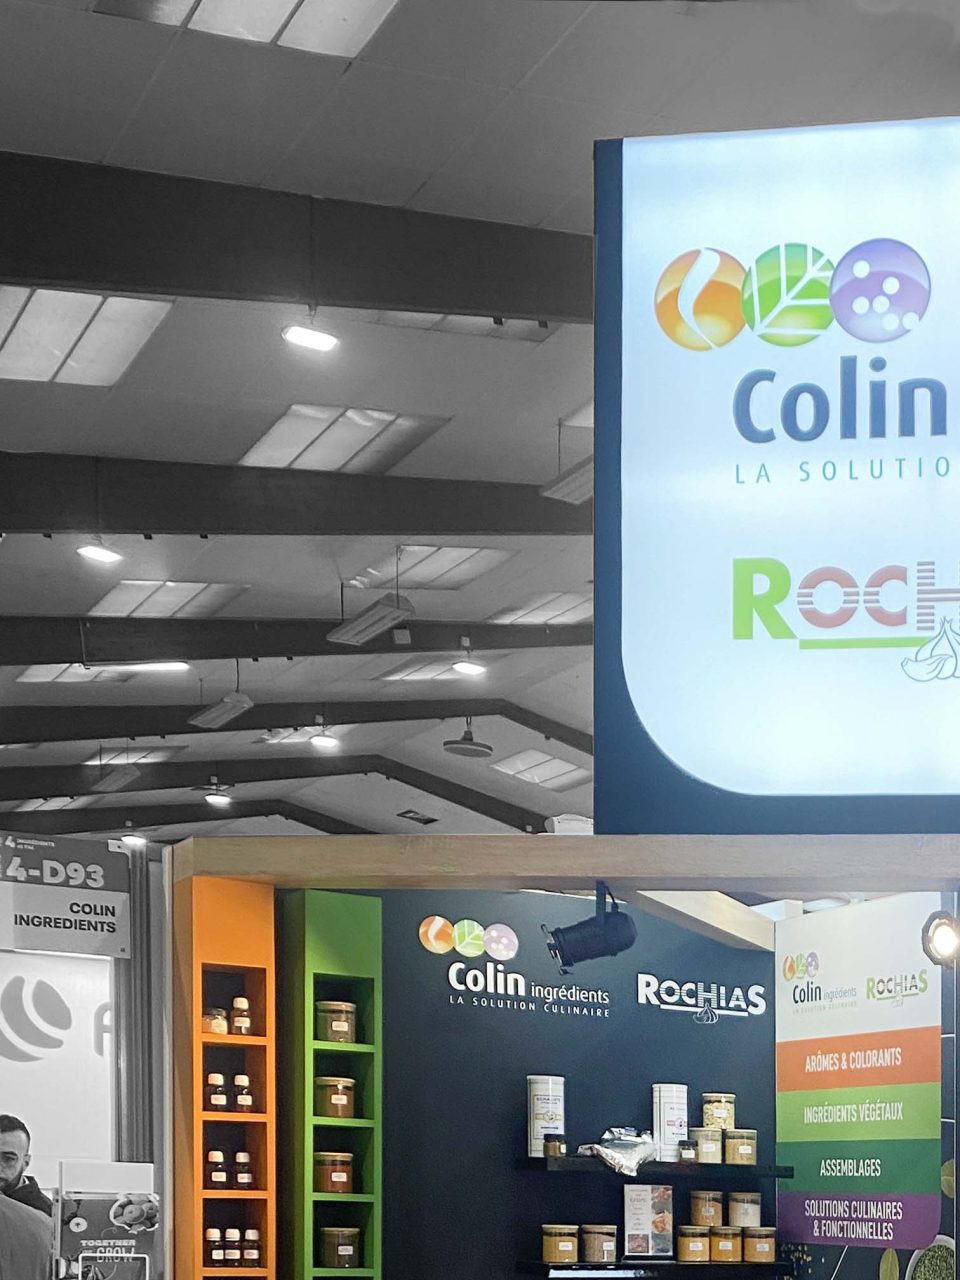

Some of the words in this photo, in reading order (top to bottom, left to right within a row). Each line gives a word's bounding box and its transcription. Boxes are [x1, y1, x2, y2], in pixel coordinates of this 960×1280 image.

[733, 355, 947, 444] Colin
[735, 463, 771, 484] LA
[69, 902, 116, 917] COLIN
[14, 914, 116, 933] INGREDIENTS
[448, 962, 526, 996] Colin
[531, 982, 609, 1004] ingrédients
[637, 973, 766, 1016] ROCHIAS
[793, 981, 822, 1004] Colin
[866, 968, 928, 1000] ROCHIAS
[450, 995, 464, 1005] LA
[472, 997, 536, 1011] SOLUTION
[544, 1004, 609, 1018] CULINAIRE
[805, 1049, 839, 1073] ARÔMES
[840, 1052, 848, 1070] &
[849, 1047, 902, 1069] COLORANTS
[804, 1101, 858, 1124] INGRÉDIENTS
[858, 1098, 904, 1121] VÉGÉTAUX
[819, 1159, 881, 1177] ASSEMBLAGES
[804, 1199, 850, 1218] SOLUTIONS
[850, 1200, 903, 1220] CULINAIRES
[813, 1219, 820, 1237] &
[821, 1220, 894, 1241] FONCTIONNELLES
